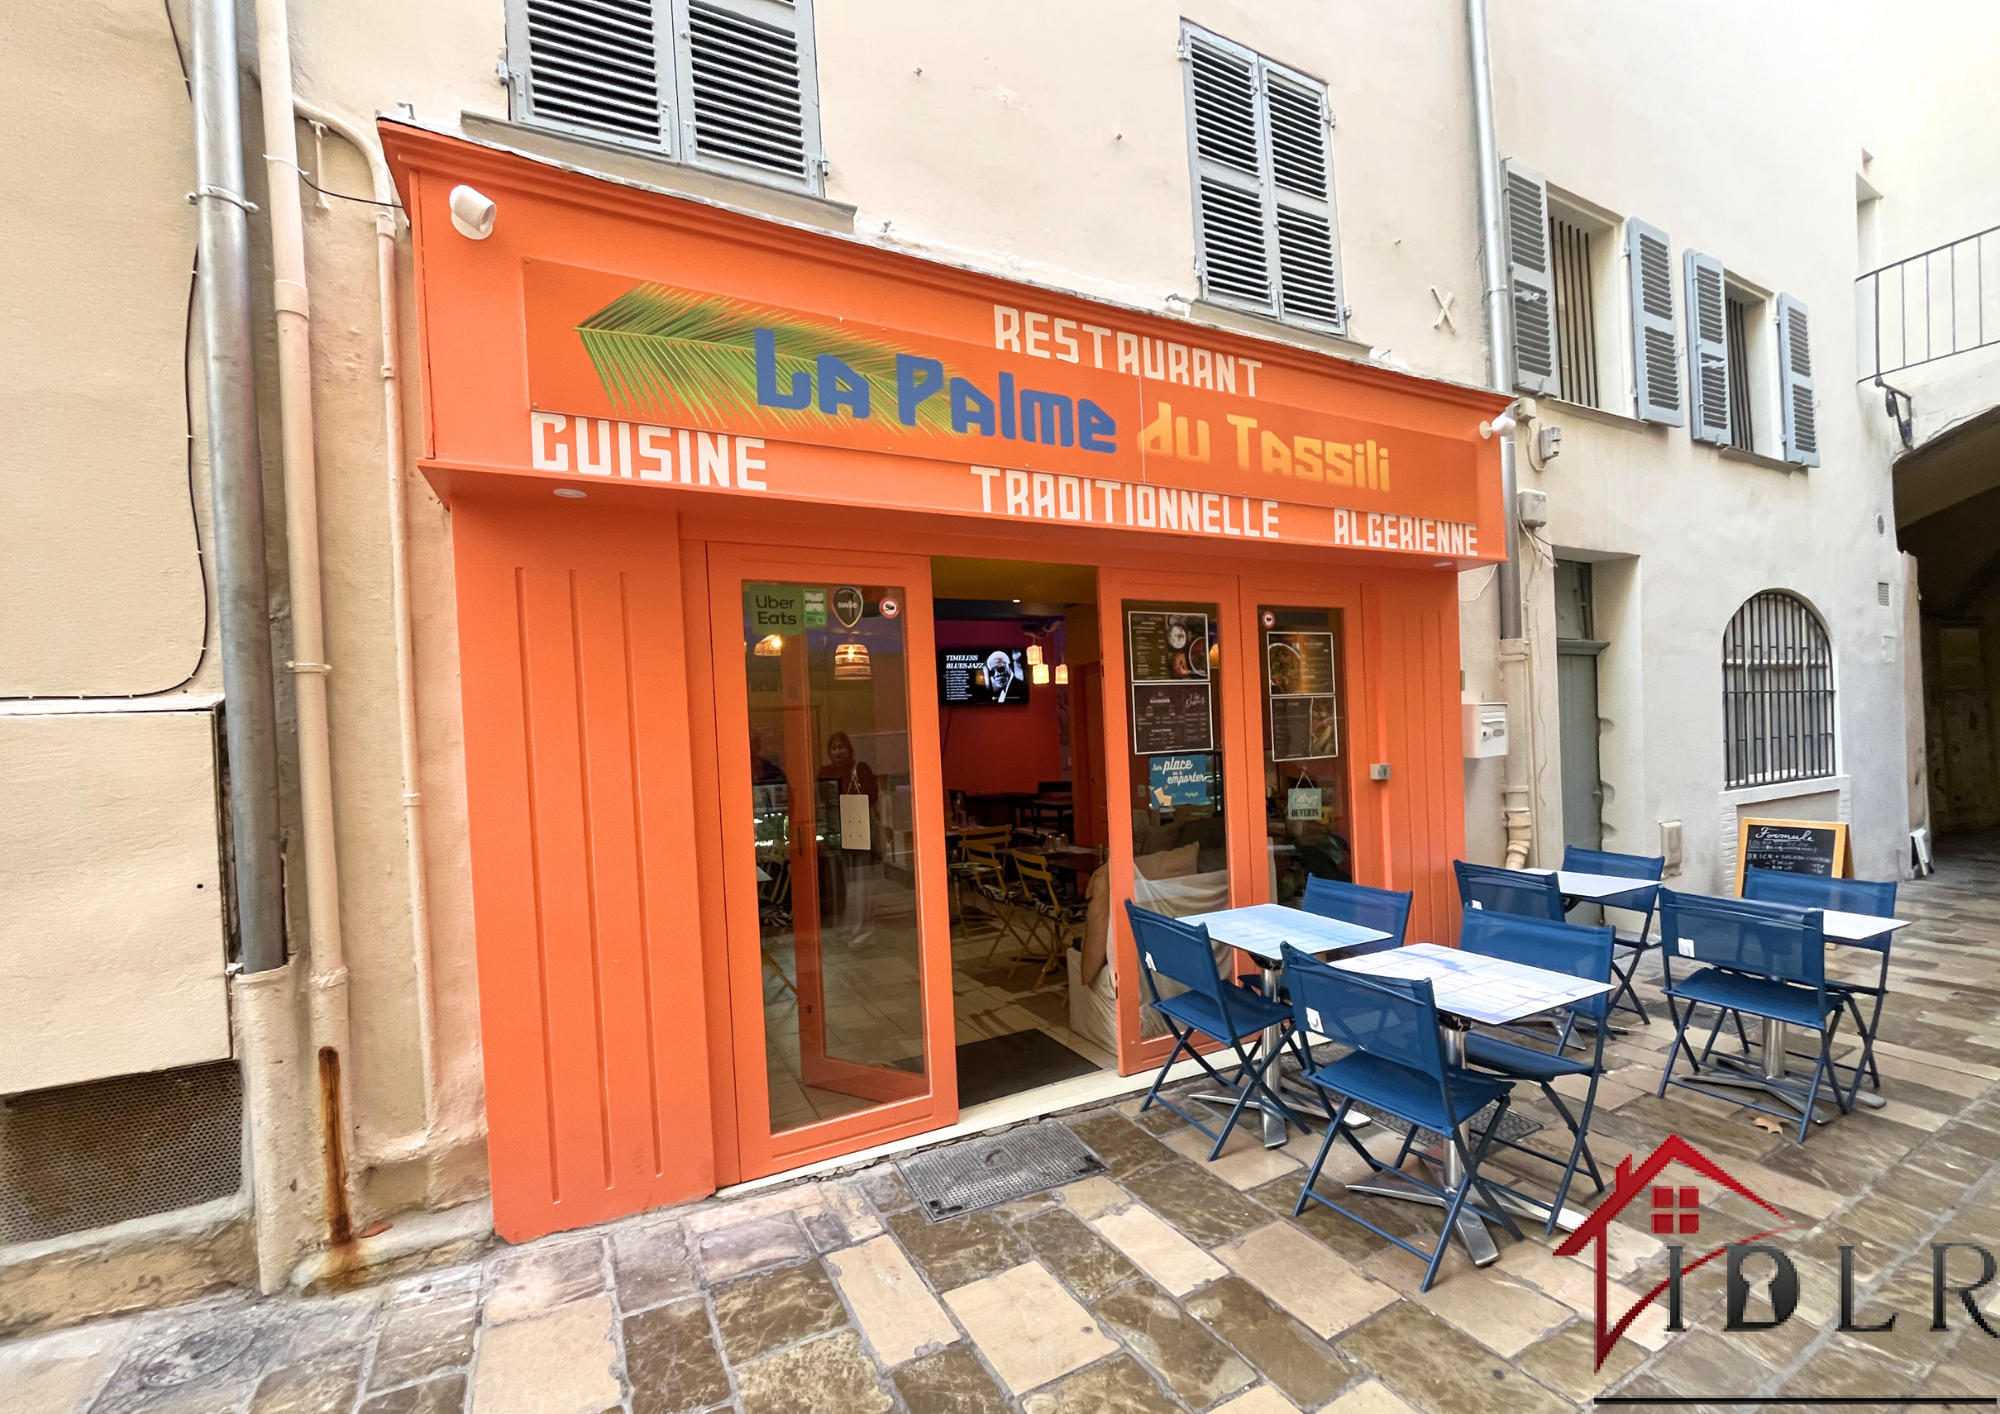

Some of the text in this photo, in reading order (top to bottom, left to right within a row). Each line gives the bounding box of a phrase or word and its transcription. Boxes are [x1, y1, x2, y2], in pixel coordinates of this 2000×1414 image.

[994, 304, 1262, 397] RESTAURANT
[1137, 401, 1211, 464] du
[531, 412, 1478, 557] CUISINE TRADITIONNELLE ALGERIENNE
[755, 595, 797, 625] Uber Eats
[1162, 756, 1194, 775] place
[1167, 771, 1205, 787] emporter
[1755, 826, 1814, 841] Formule
[1747, 852, 1773, 860] BRICK
